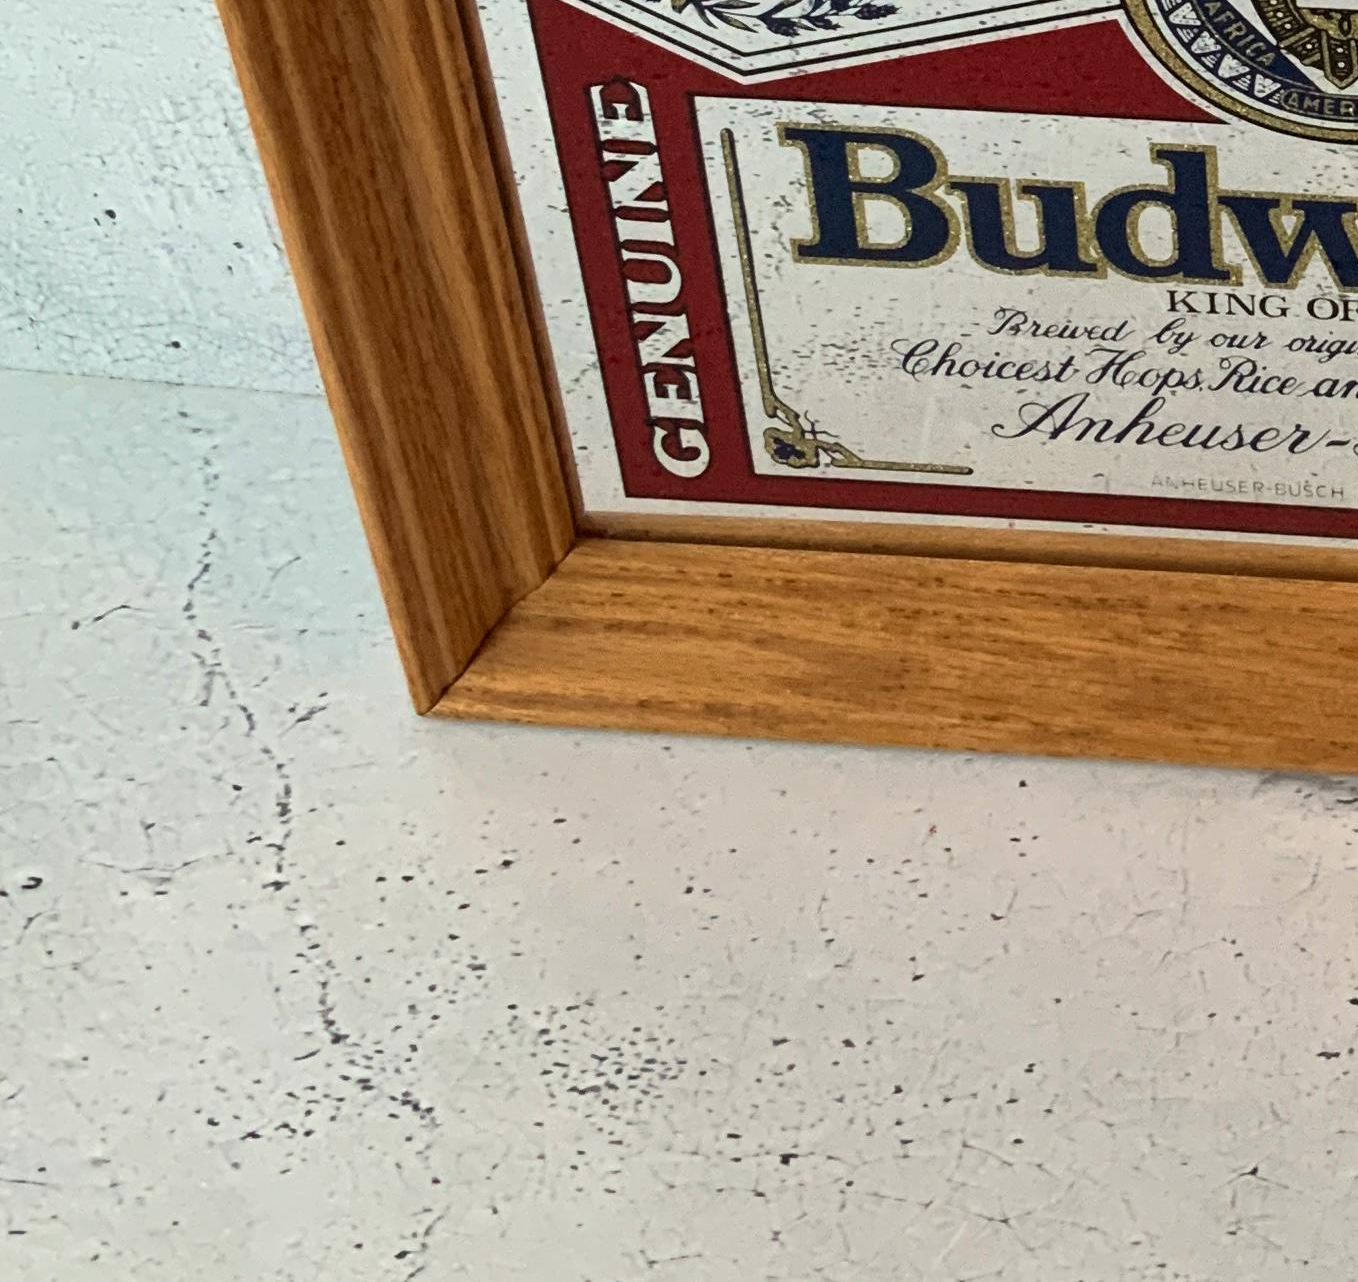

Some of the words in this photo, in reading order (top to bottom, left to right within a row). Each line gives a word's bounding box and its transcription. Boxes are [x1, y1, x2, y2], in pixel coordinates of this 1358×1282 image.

[1203, 0, 1277, 68] AFRICA
[589, 80, 710, 478] GENUINE
[1166, 289, 1290, 318] KING
[988, 307, 1135, 342] Brewed
[1151, 318, 1200, 354] by
[1209, 330, 1273, 350] our
[891, 338, 1079, 383] Choicest
[1208, 355, 1305, 395] Rice
[1152, 475, 1344, 499] ANHEUSER-BUSCH
